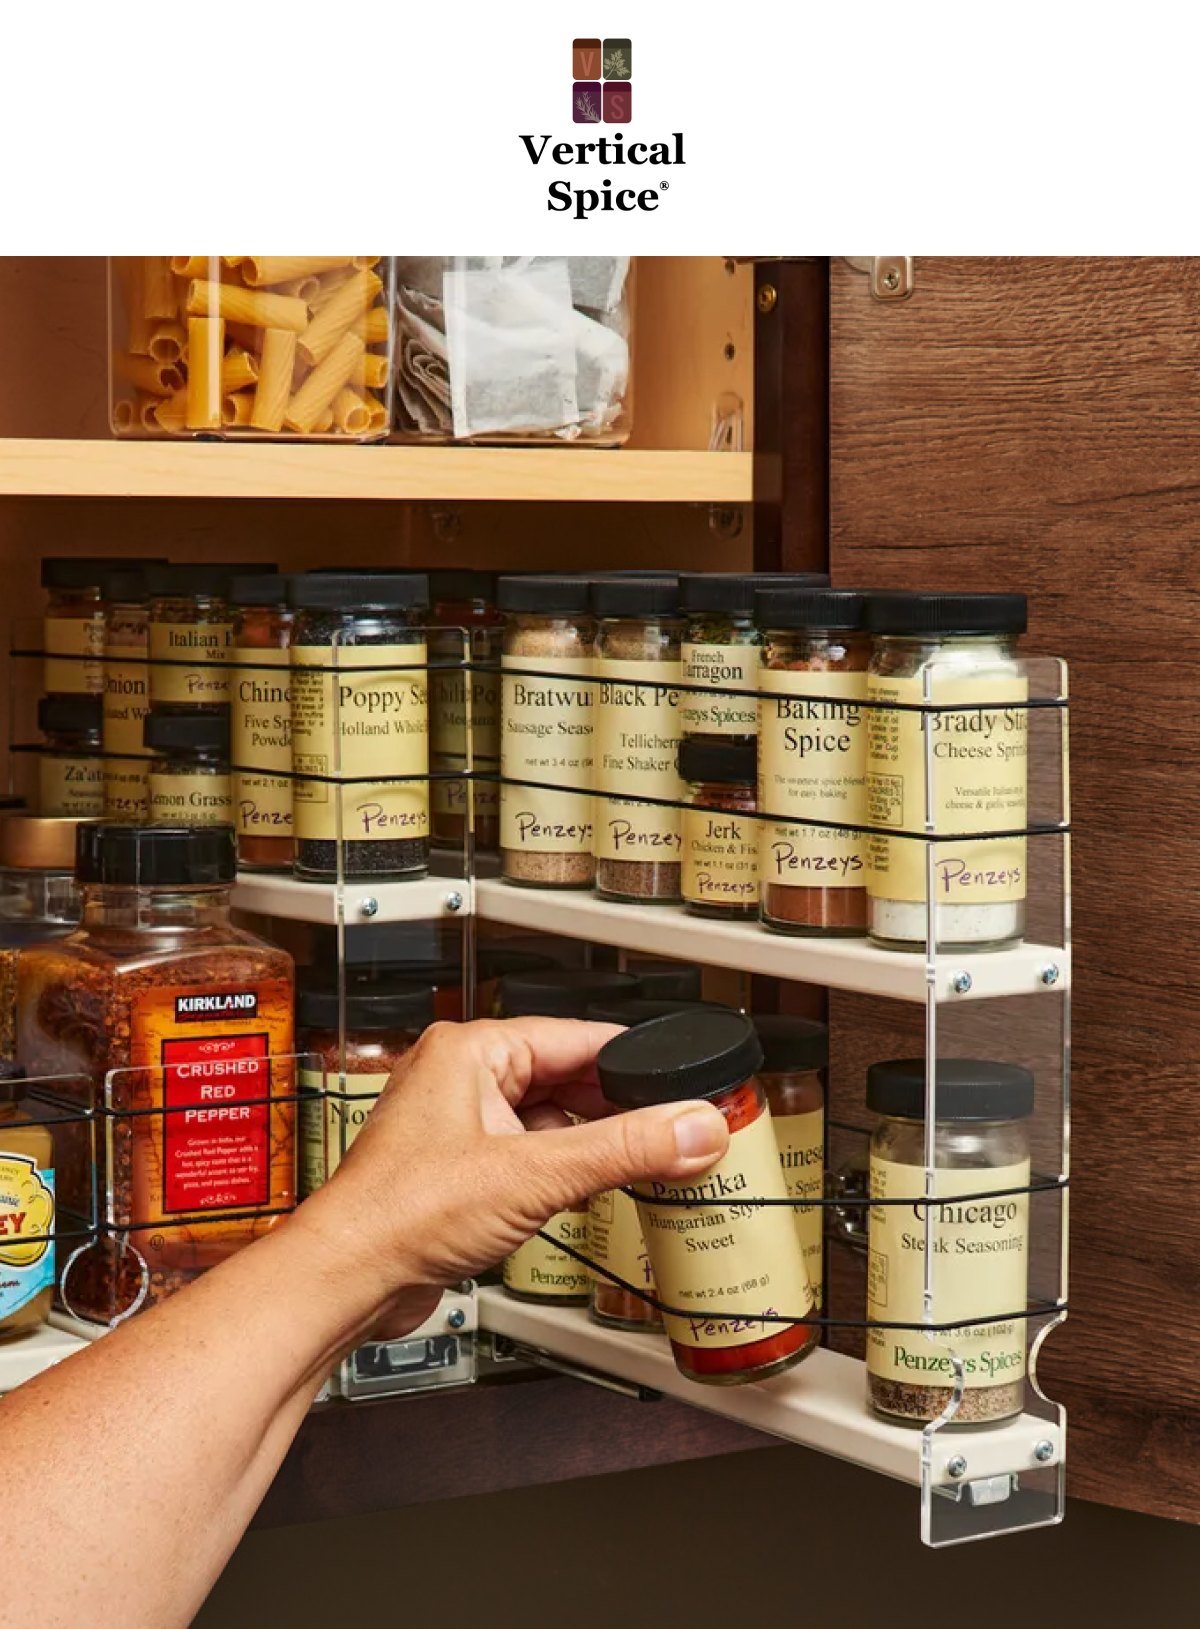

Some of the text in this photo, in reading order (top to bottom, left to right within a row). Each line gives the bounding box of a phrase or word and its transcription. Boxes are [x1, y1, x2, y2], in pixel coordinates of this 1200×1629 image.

[168, 631, 219, 647] Italian
[691, 649, 725, 664] French
[339, 685, 404, 714] Poppy
[599, 682, 647, 707] Black
[655, 686, 679, 708] Pe
[244, 714, 270, 732] Five
[711, 705, 756, 727] Spices
[776, 698, 862, 728] Baking
[919, 709, 997, 739] Brady
[507, 718, 553, 741] Sausage
[784, 726, 851, 758] Spice
[934, 742, 993, 758] Cheese
[603, 755, 671, 772] Fine Shaker
[190, 792, 231, 808] Grass
[356, 802, 428, 835] Penzeys
[705, 820, 742, 841] Jerk
[691, 840, 724, 853] Chicken
[726, 844, 736, 855] &
[770, 841, 864, 878] Penzeys
[696, 872, 756, 894] Penzeys
[935, 858, 1020, 893] Penzeys
[177, 994, 257, 1012] KIRKLAND
[176, 1061, 259, 1079] CRUSHED
[201, 1084, 236, 1100] RED
[185, 1106, 251, 1123] PEPPER
[651, 1171, 748, 1210] Paprika
[648, 1212, 727, 1235] Hungarian
[913, 1201, 1018, 1230] Chicago
[684, 1234, 736, 1254] Sweet
[900, 1231, 1025, 1255] Steak Seasoning
[531, 1267, 587, 1291] Penzeys
[678, 1289, 693, 1300] net
[695, 1289, 707, 1300] wt
[707, 1286, 725, 1298] 2.4
[726, 1284, 740, 1295] oz
[893, 1345, 1022, 1380] Penzeys Spices
